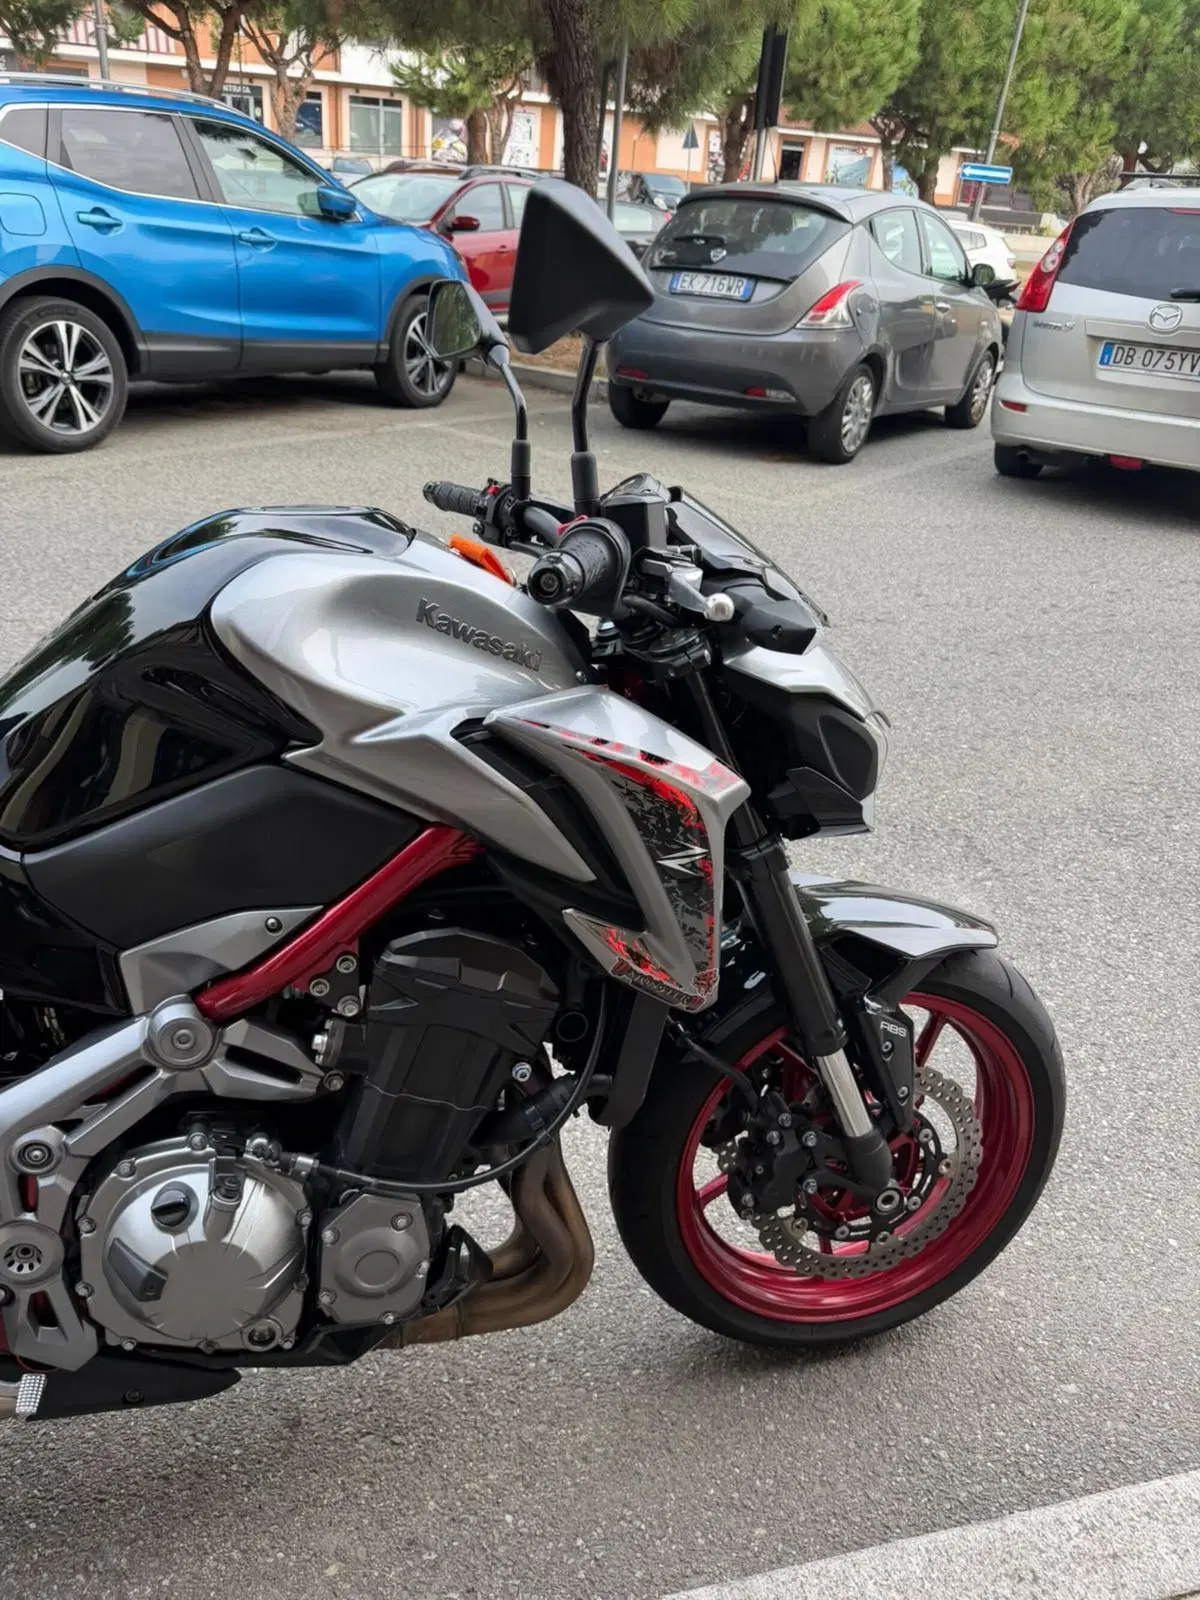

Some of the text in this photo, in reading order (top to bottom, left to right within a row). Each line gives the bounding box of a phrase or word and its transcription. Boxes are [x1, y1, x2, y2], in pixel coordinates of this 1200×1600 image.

[222, 84, 252, 94] NTRATA
[679, 273, 745, 293] EK 716WR
[1112, 346, 1200, 374] DB 075YV
[415, 597, 543, 672] Kawasaki
[880, 1021, 907, 1038] ABS
